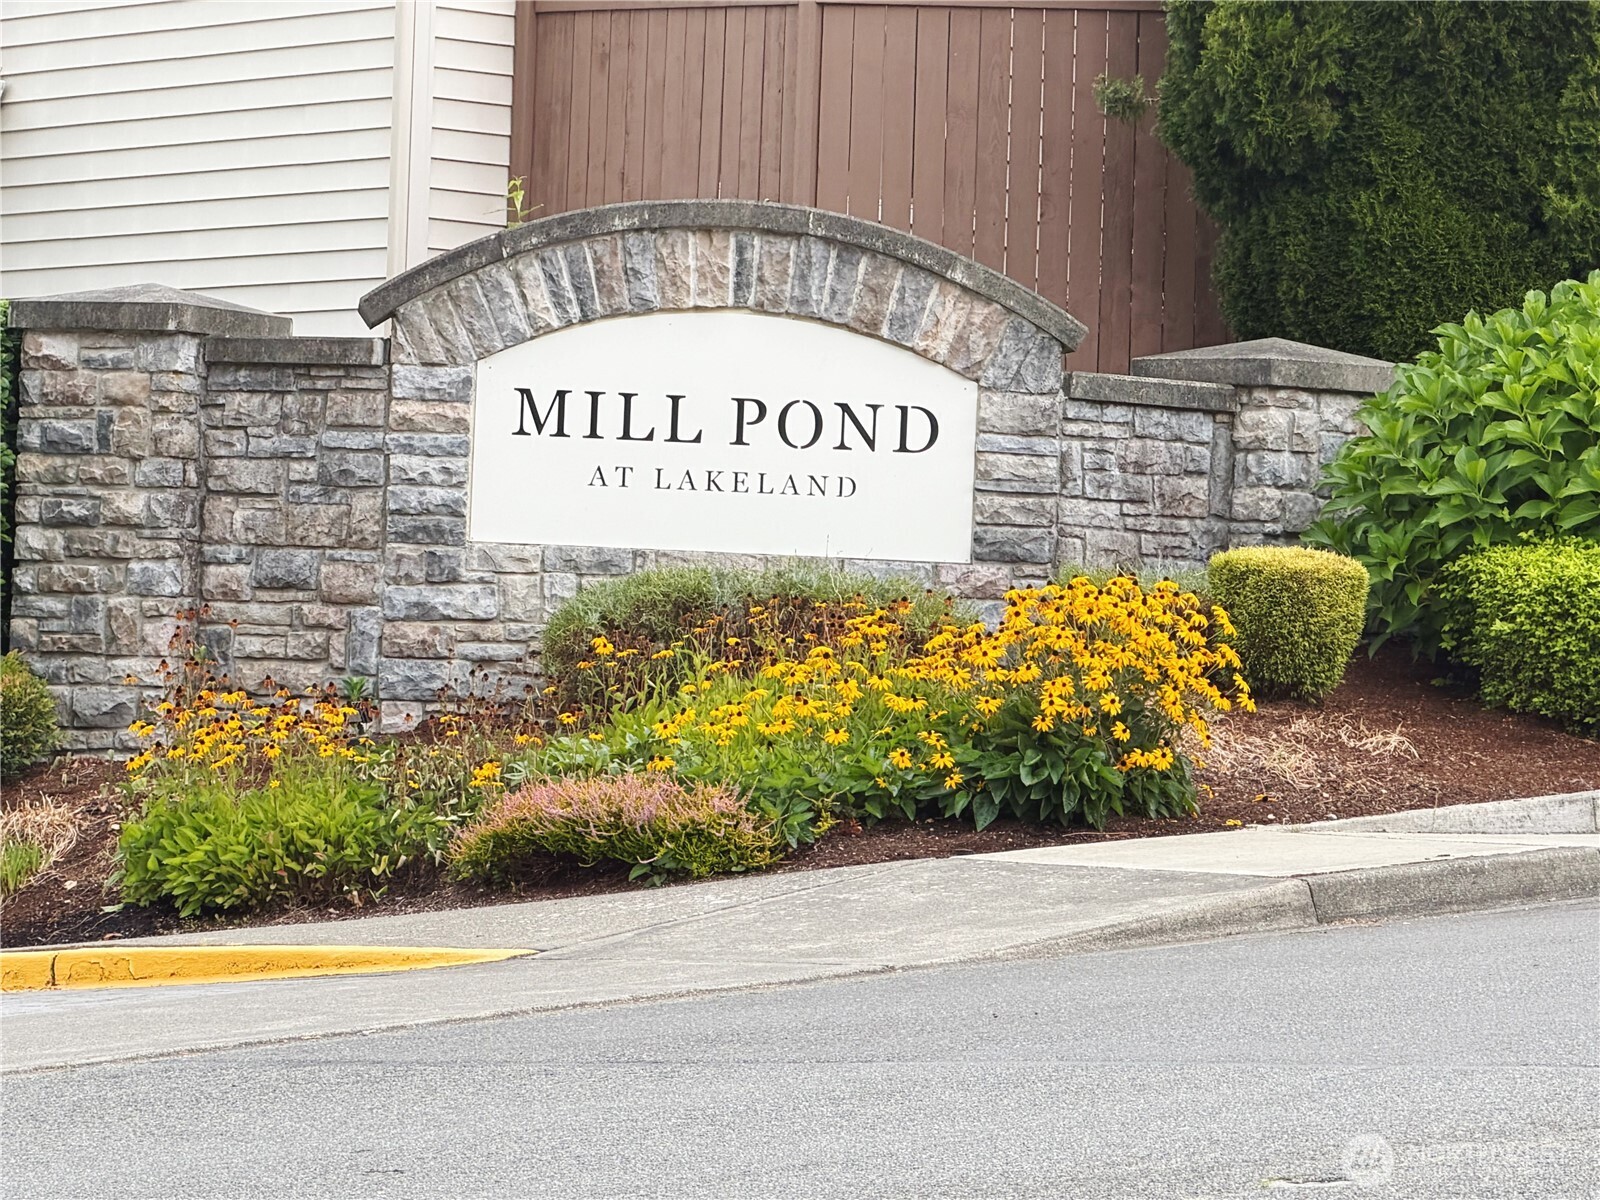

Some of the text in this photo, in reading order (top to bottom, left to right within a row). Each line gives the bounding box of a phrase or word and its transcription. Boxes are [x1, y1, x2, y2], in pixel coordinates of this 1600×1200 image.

[511, 387, 940, 454] MILL POND
[587, 465, 859, 498] AT LAKELAND
